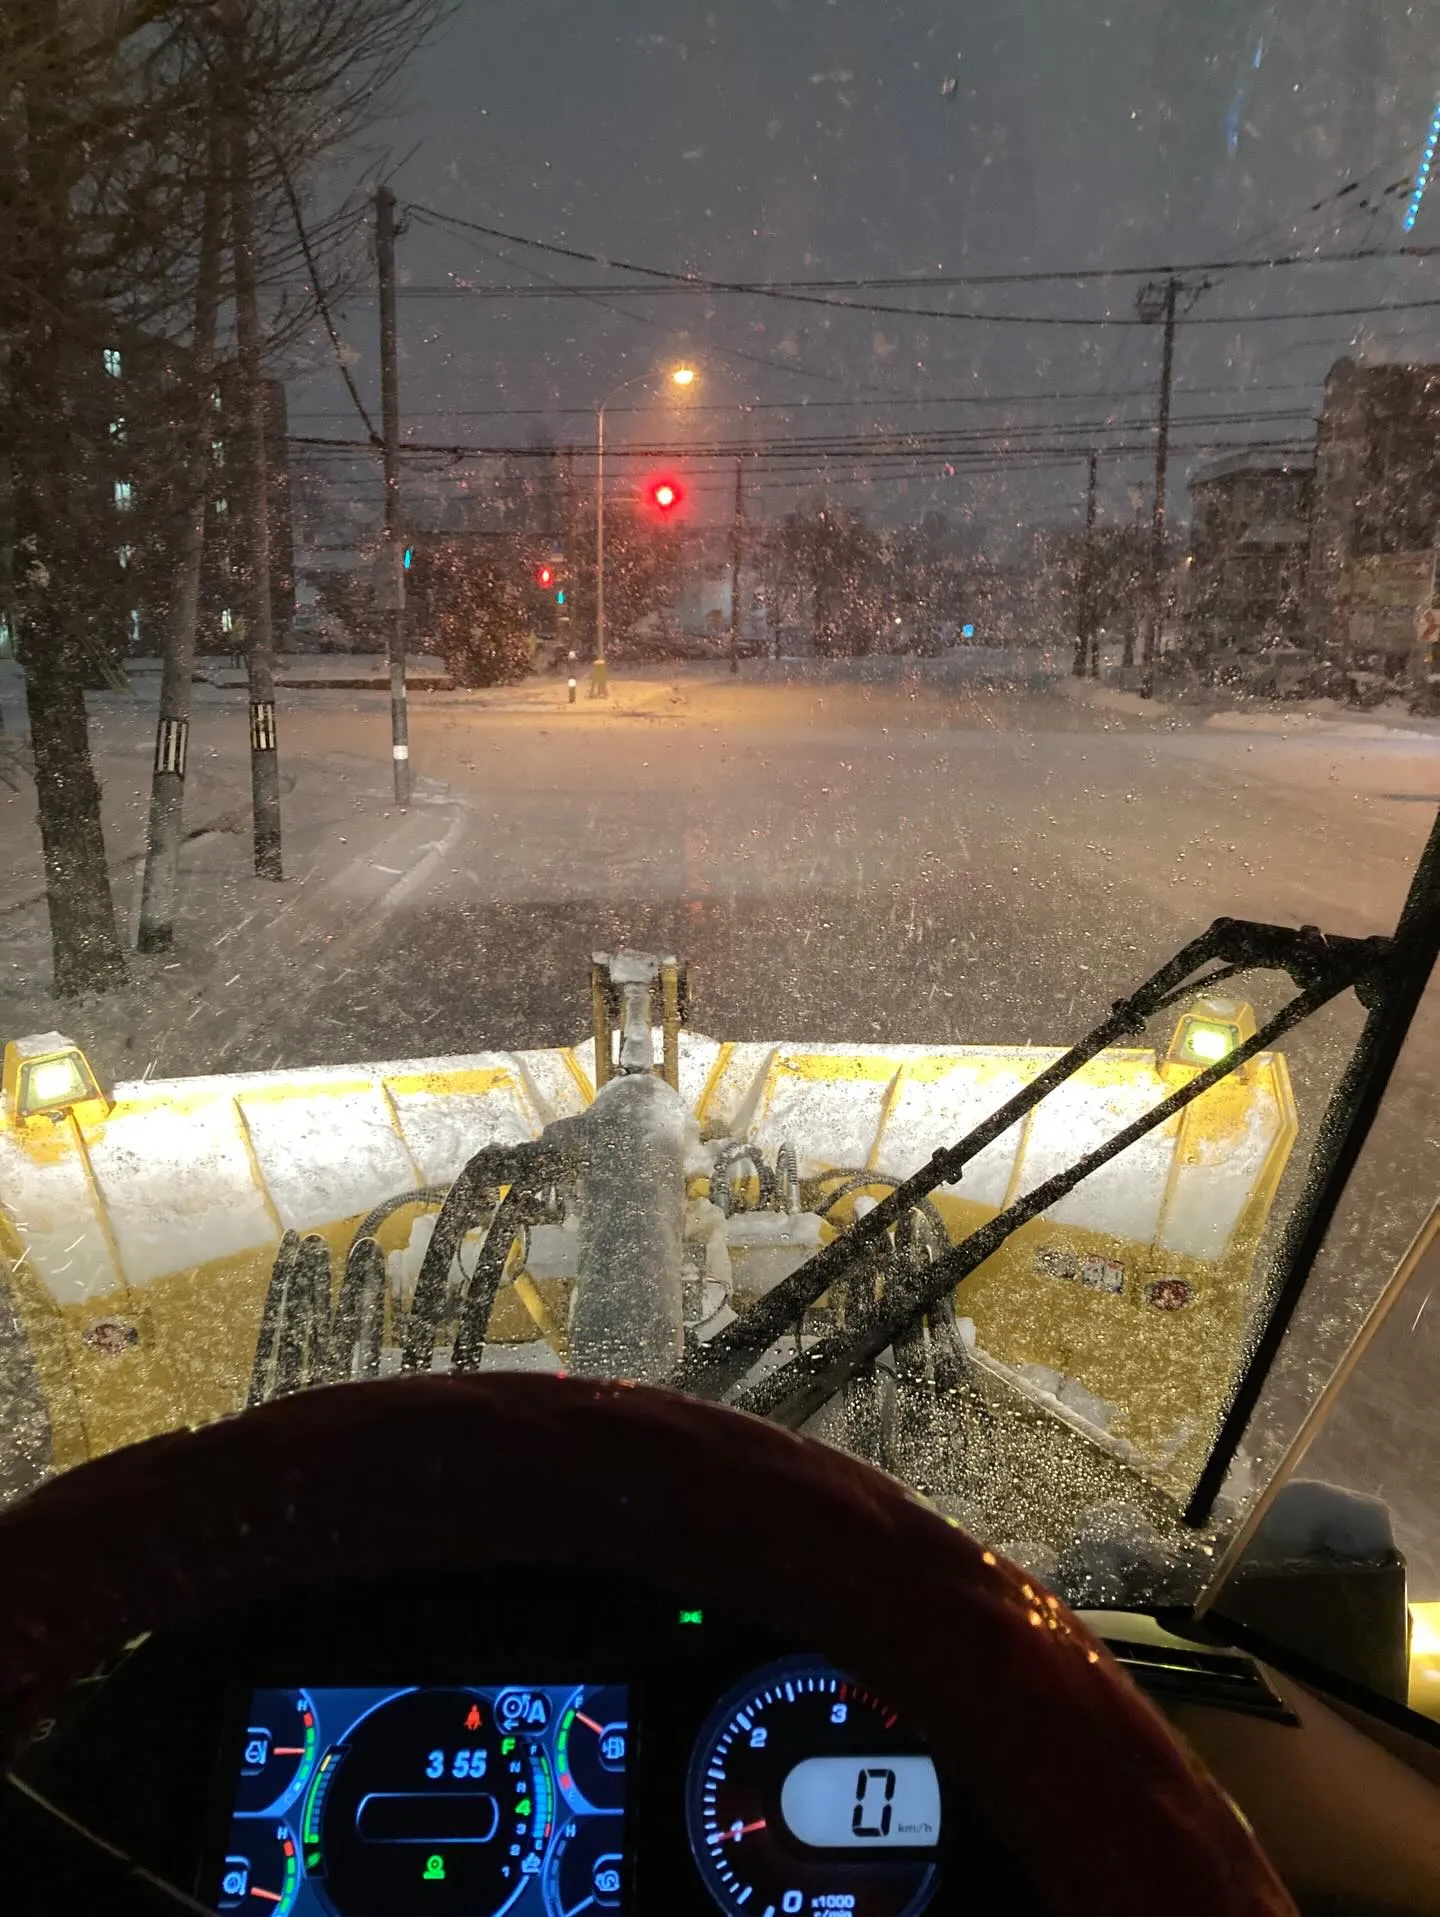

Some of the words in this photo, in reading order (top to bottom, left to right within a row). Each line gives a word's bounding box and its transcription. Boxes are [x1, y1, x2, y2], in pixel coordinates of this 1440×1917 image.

[527, 1699, 546, 1723] A
[831, 1703, 848, 1723] 3
[502, 1737, 516, 1755] F
[750, 1727, 768, 1747] 2
[425, 1749, 444, 1778] 3
[452, 1748, 488, 1778] 55
[510, 1760, 521, 1773] N
[514, 1798, 531, 1816] 4
[852, 1769, 896, 1837] 0
[516, 1823, 527, 1835] 3
[565, 1823, 577, 1837] H
[730, 1820, 744, 1841] 1
[897, 1821, 933, 1833] km/h
[783, 1889, 803, 1913] 0
[811, 1893, 856, 1908] x1000
